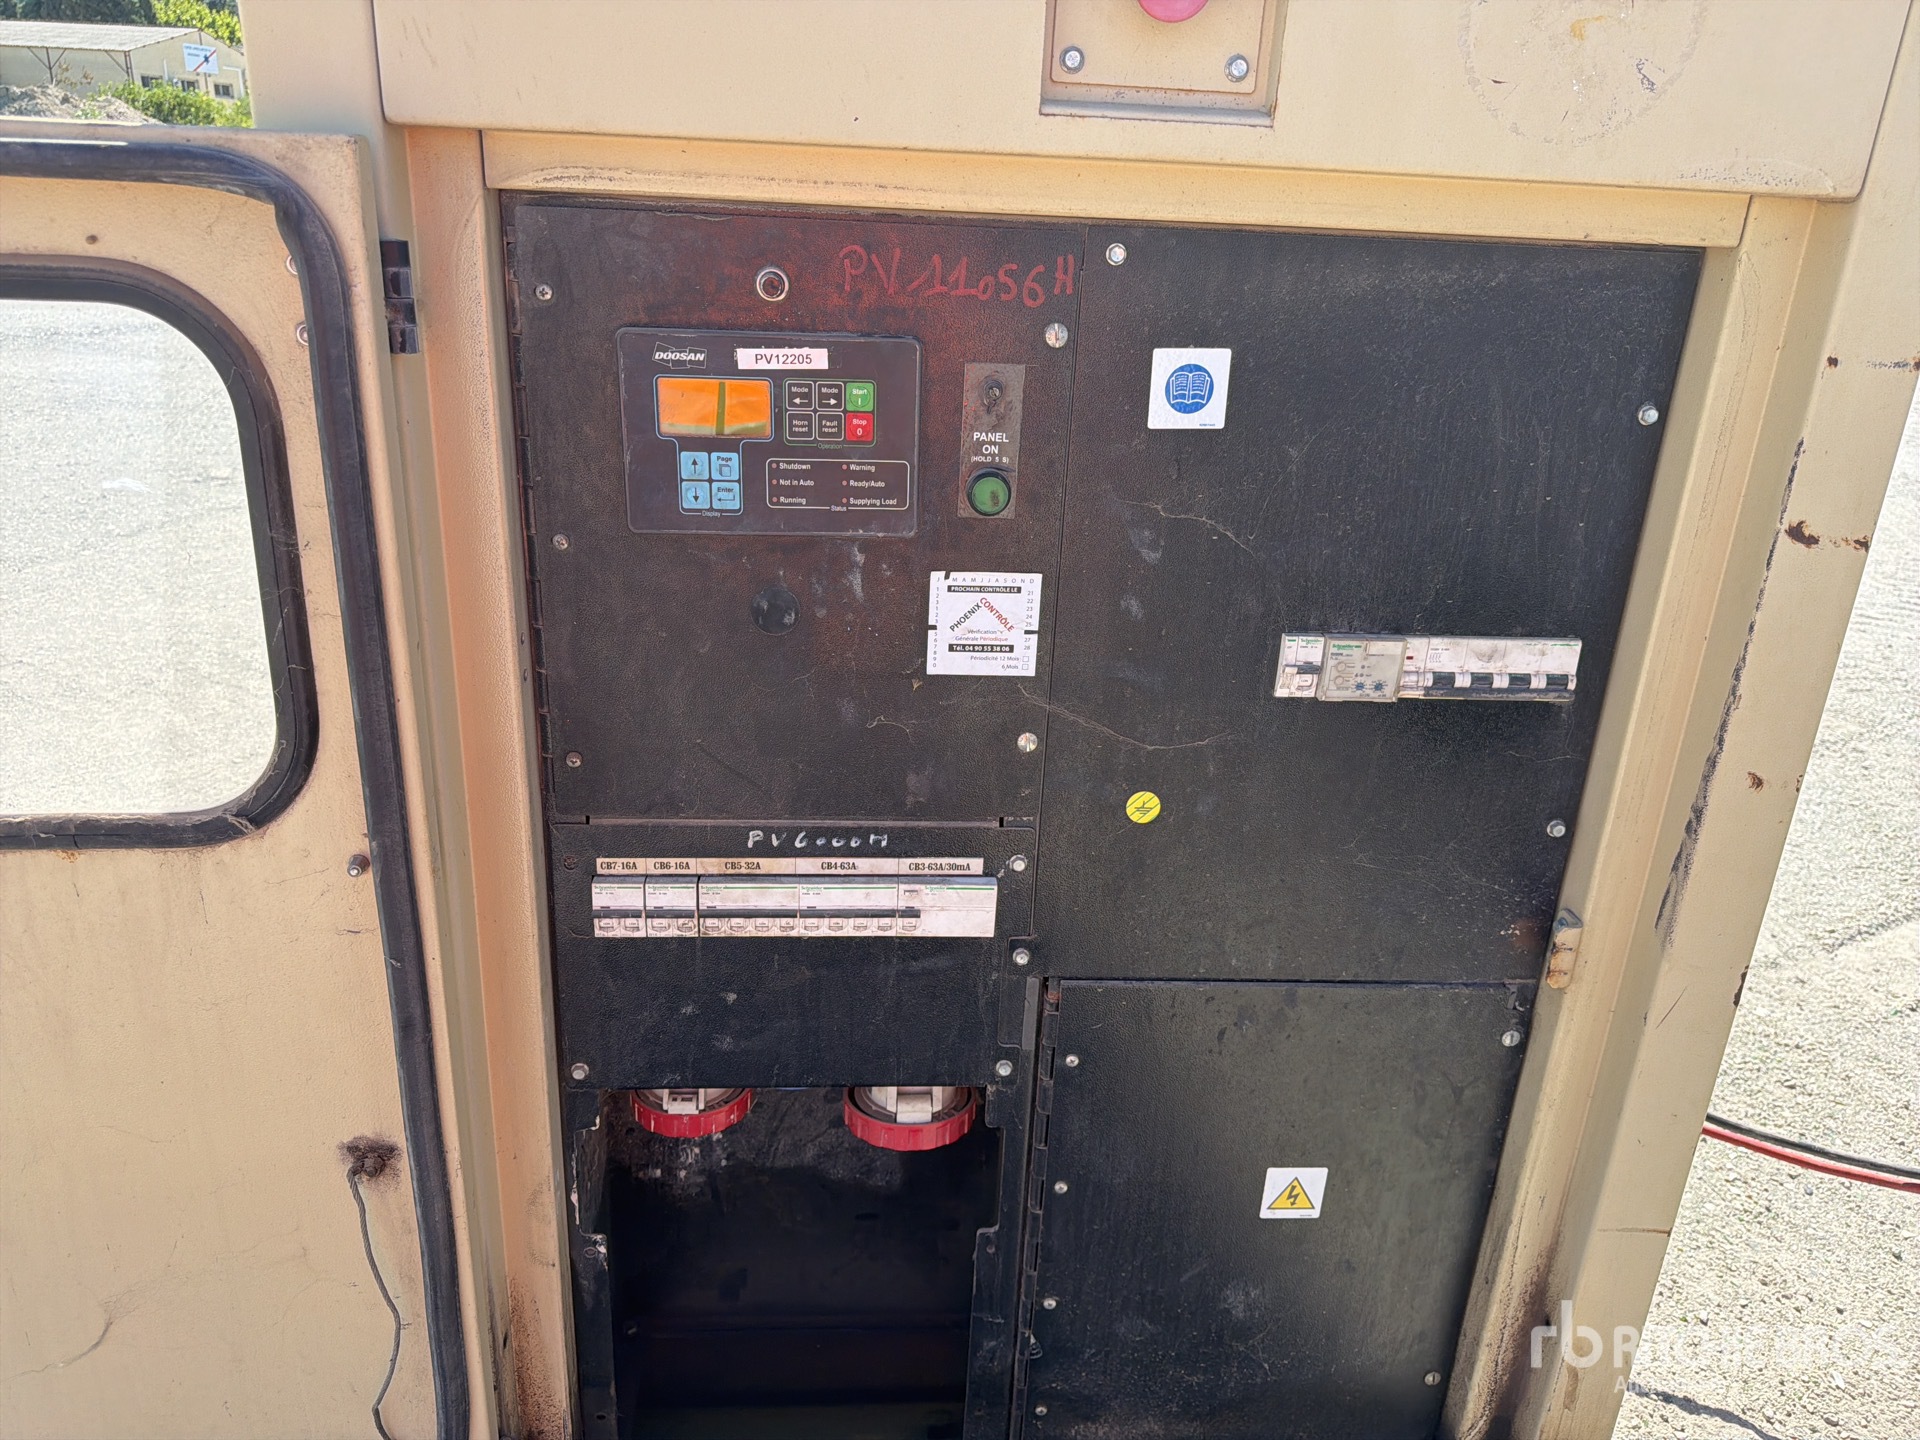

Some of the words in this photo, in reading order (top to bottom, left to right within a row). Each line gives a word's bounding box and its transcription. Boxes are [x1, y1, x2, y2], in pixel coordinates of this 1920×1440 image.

[654, 351, 705, 361] DOOSAN
[755, 353, 813, 365] PV12205
[852, 418, 867, 426] Stop
[973, 432, 1009, 443] PANEL
[817, 442, 842, 450] Operation
[982, 444, 999, 454] ON
[716, 455, 733, 463] Page
[970, 455, 992, 463] (HOLD
[1002, 456, 1010, 464] S)
[849, 464, 876, 472] Warning
[849, 479, 886, 488] Ready/Auto
[779, 497, 807, 505] Running
[849, 498, 880, 506] Supplying
[701, 510, 721, 518] Display
[949, 602, 982, 632] PHOENIX
[980, 597, 1015, 632] CONTRÔLE
[600, 861, 638, 870] CB7-16A
[653, 861, 691, 870] CB6-16A
[724, 861, 761, 870] CB5-32A
[820, 861, 857, 871] CB4-63A
[908, 862, 971, 871] CB3-63A/30mA
